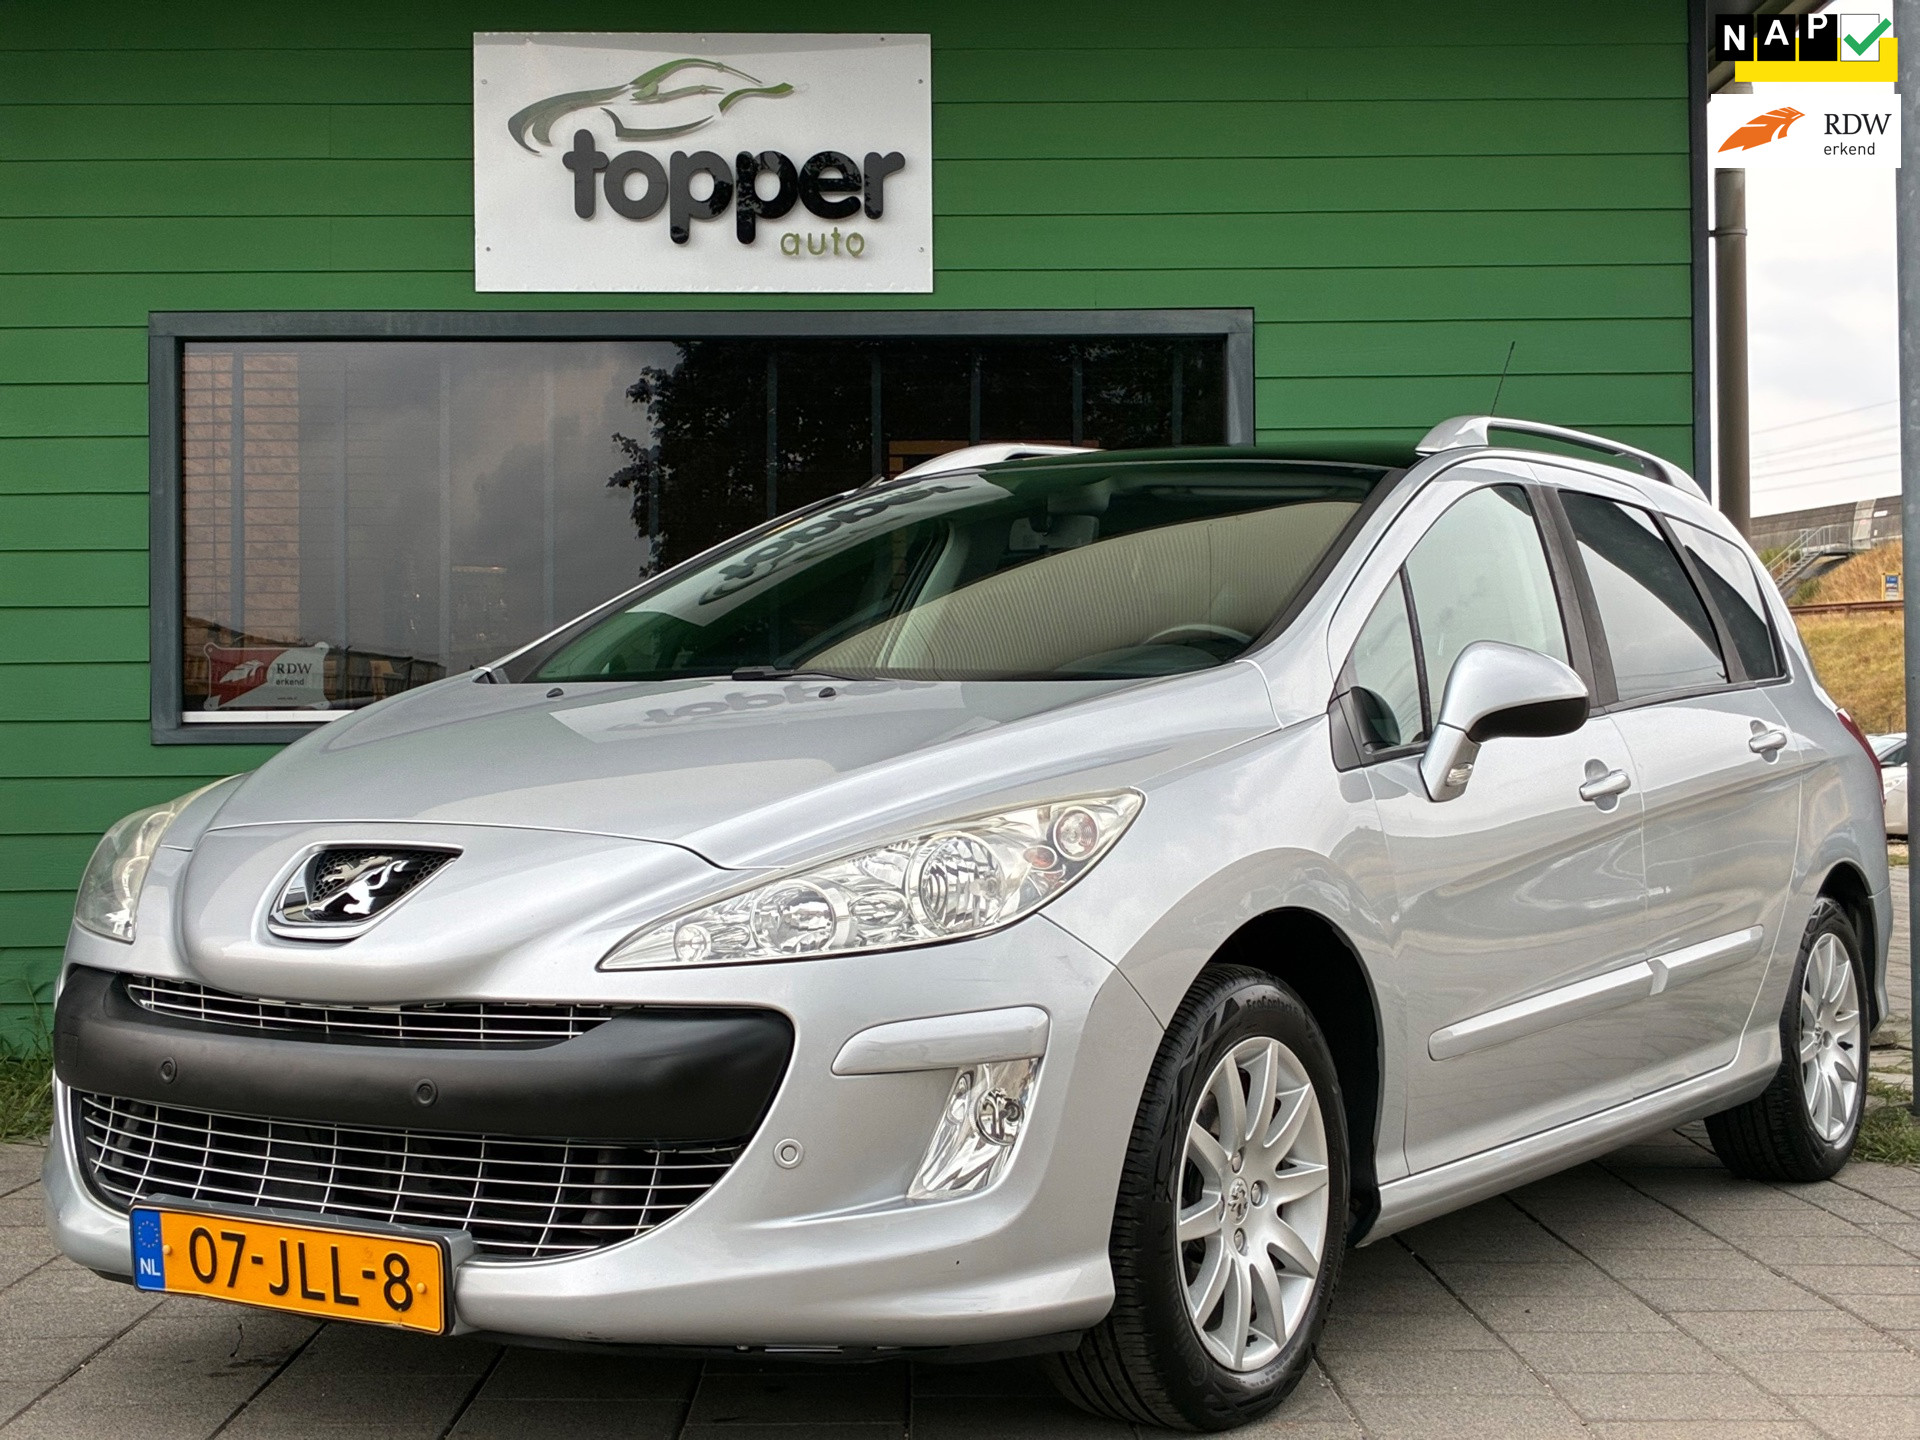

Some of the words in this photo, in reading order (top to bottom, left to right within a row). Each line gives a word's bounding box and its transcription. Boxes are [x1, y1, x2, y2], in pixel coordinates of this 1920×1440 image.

[562, 129, 906, 245] topper
[780, 227, 865, 256] auto
[276, 662, 313, 674] RDW
[275, 677, 305, 686] erkend
[139, 1257, 161, 1277] NL
[188, 1226, 414, 1313] 07-JLL-8
